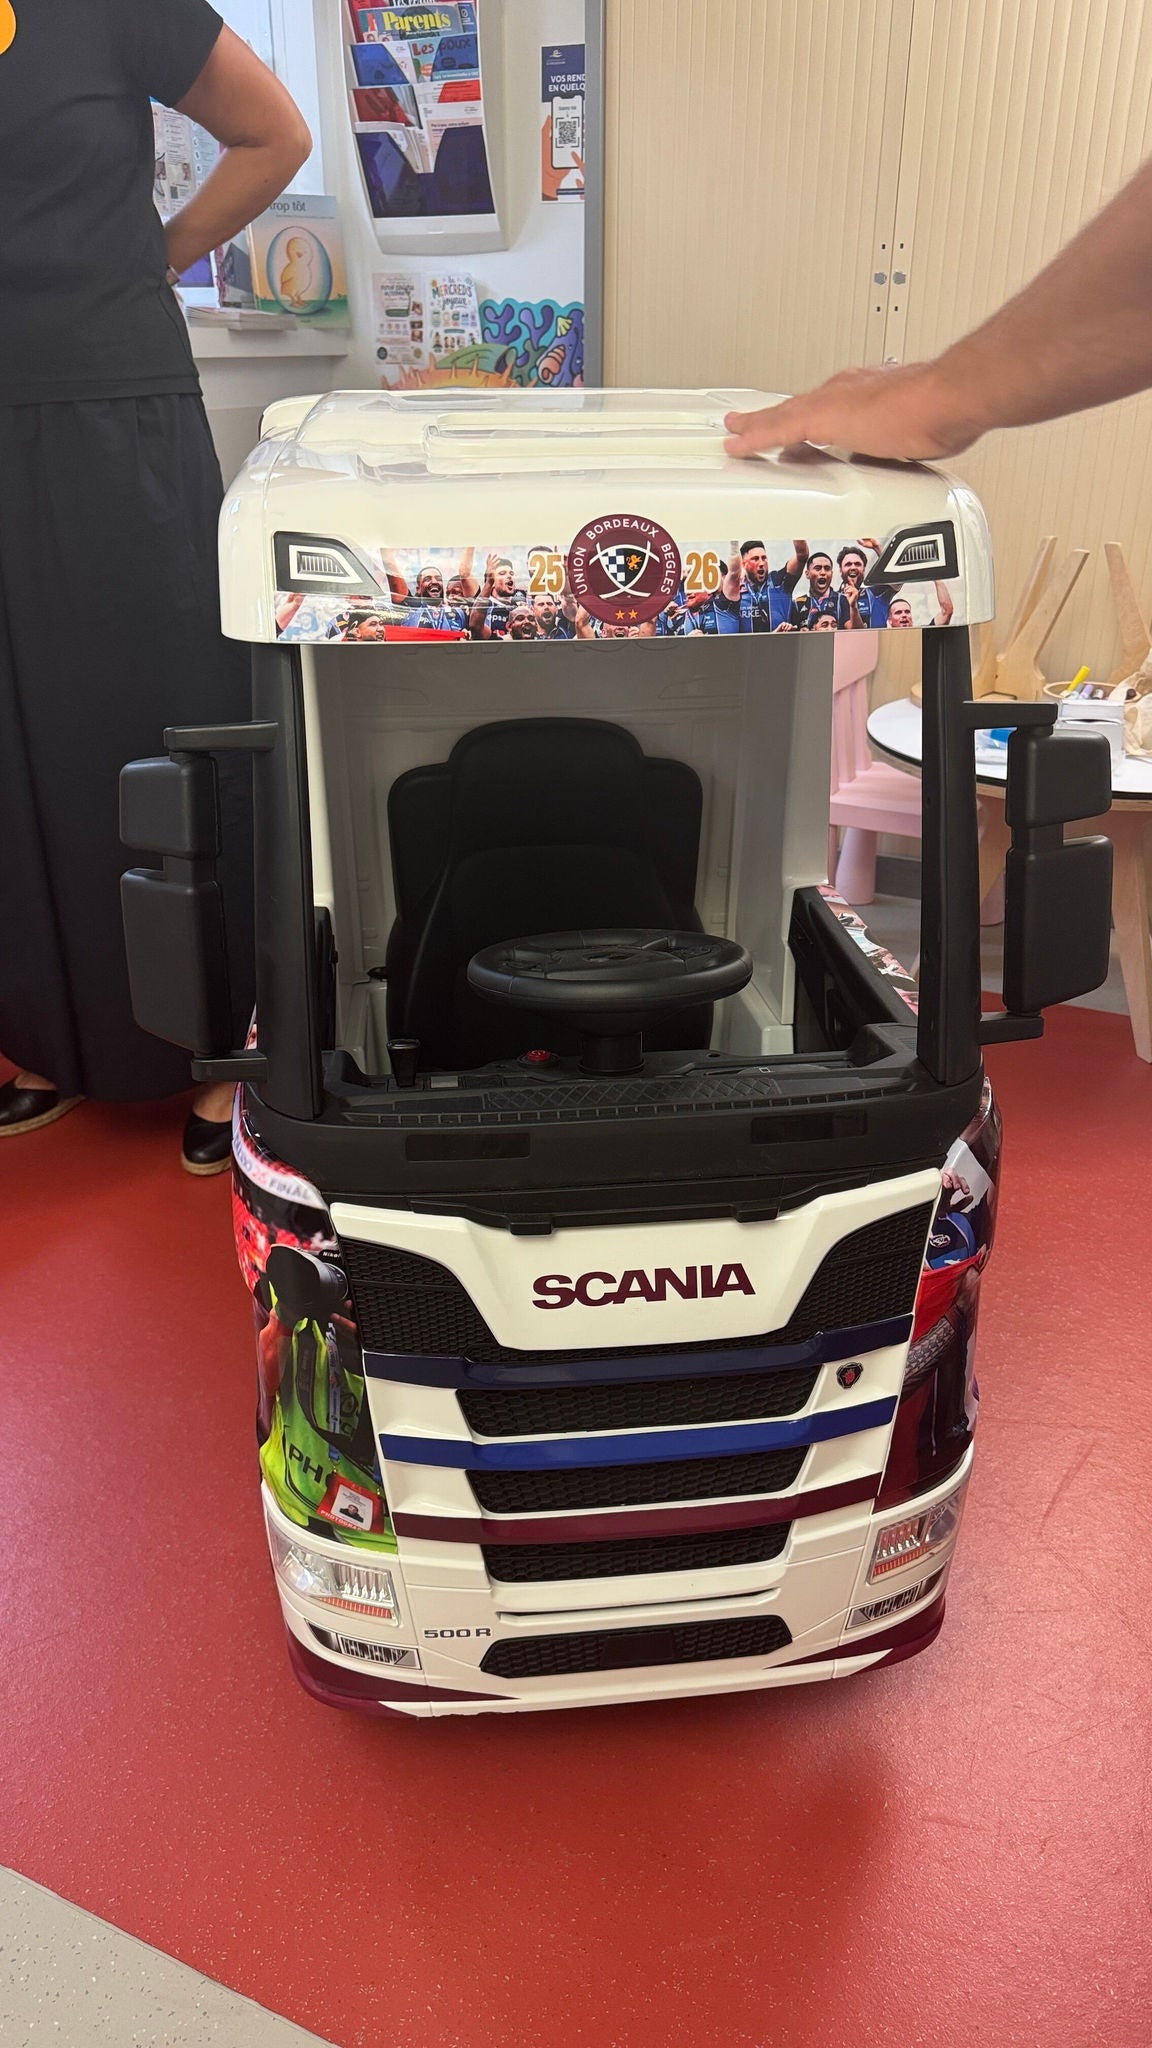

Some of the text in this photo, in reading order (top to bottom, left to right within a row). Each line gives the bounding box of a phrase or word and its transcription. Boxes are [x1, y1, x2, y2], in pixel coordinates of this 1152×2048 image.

[382, 9, 452, 32] Parents
[412, 42, 435, 56] Les
[549, 84, 559, 92] EN
[551, 75, 566, 83] VOS
[292, 200, 306, 212] tôt
[573, 518, 676, 595] UNION BORDEAUX BEGLES
[529, 554, 564, 593] 25
[686, 551, 719, 590] 26
[532, 1263, 756, 1310] SCANIA
[424, 1627, 491, 1638] 500 R
